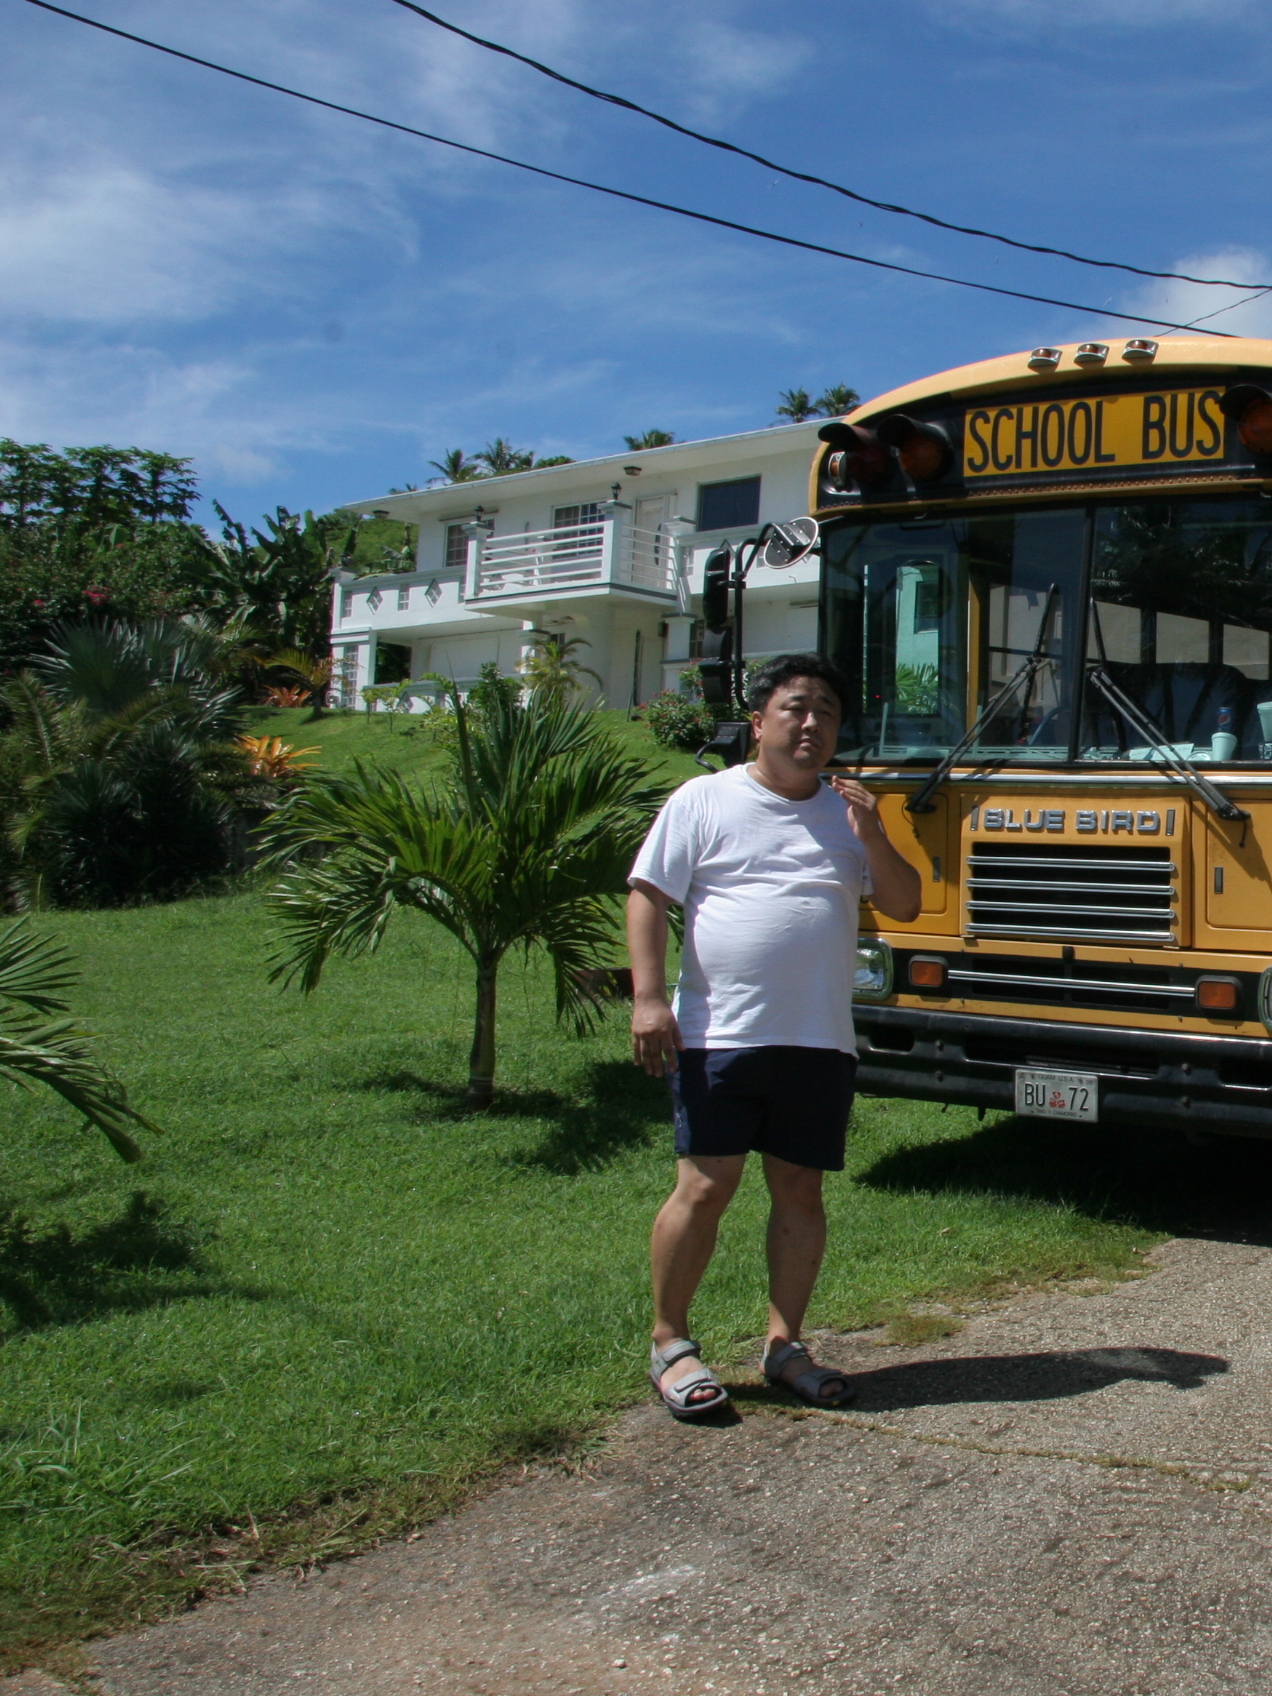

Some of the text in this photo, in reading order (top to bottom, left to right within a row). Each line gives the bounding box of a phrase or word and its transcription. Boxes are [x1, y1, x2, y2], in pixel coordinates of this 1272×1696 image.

[967, 390, 1222, 473] SCHOOL BUS
[984, 808, 1160, 832] BLUE BIRD
[1024, 1082, 1089, 1111] BU 72
